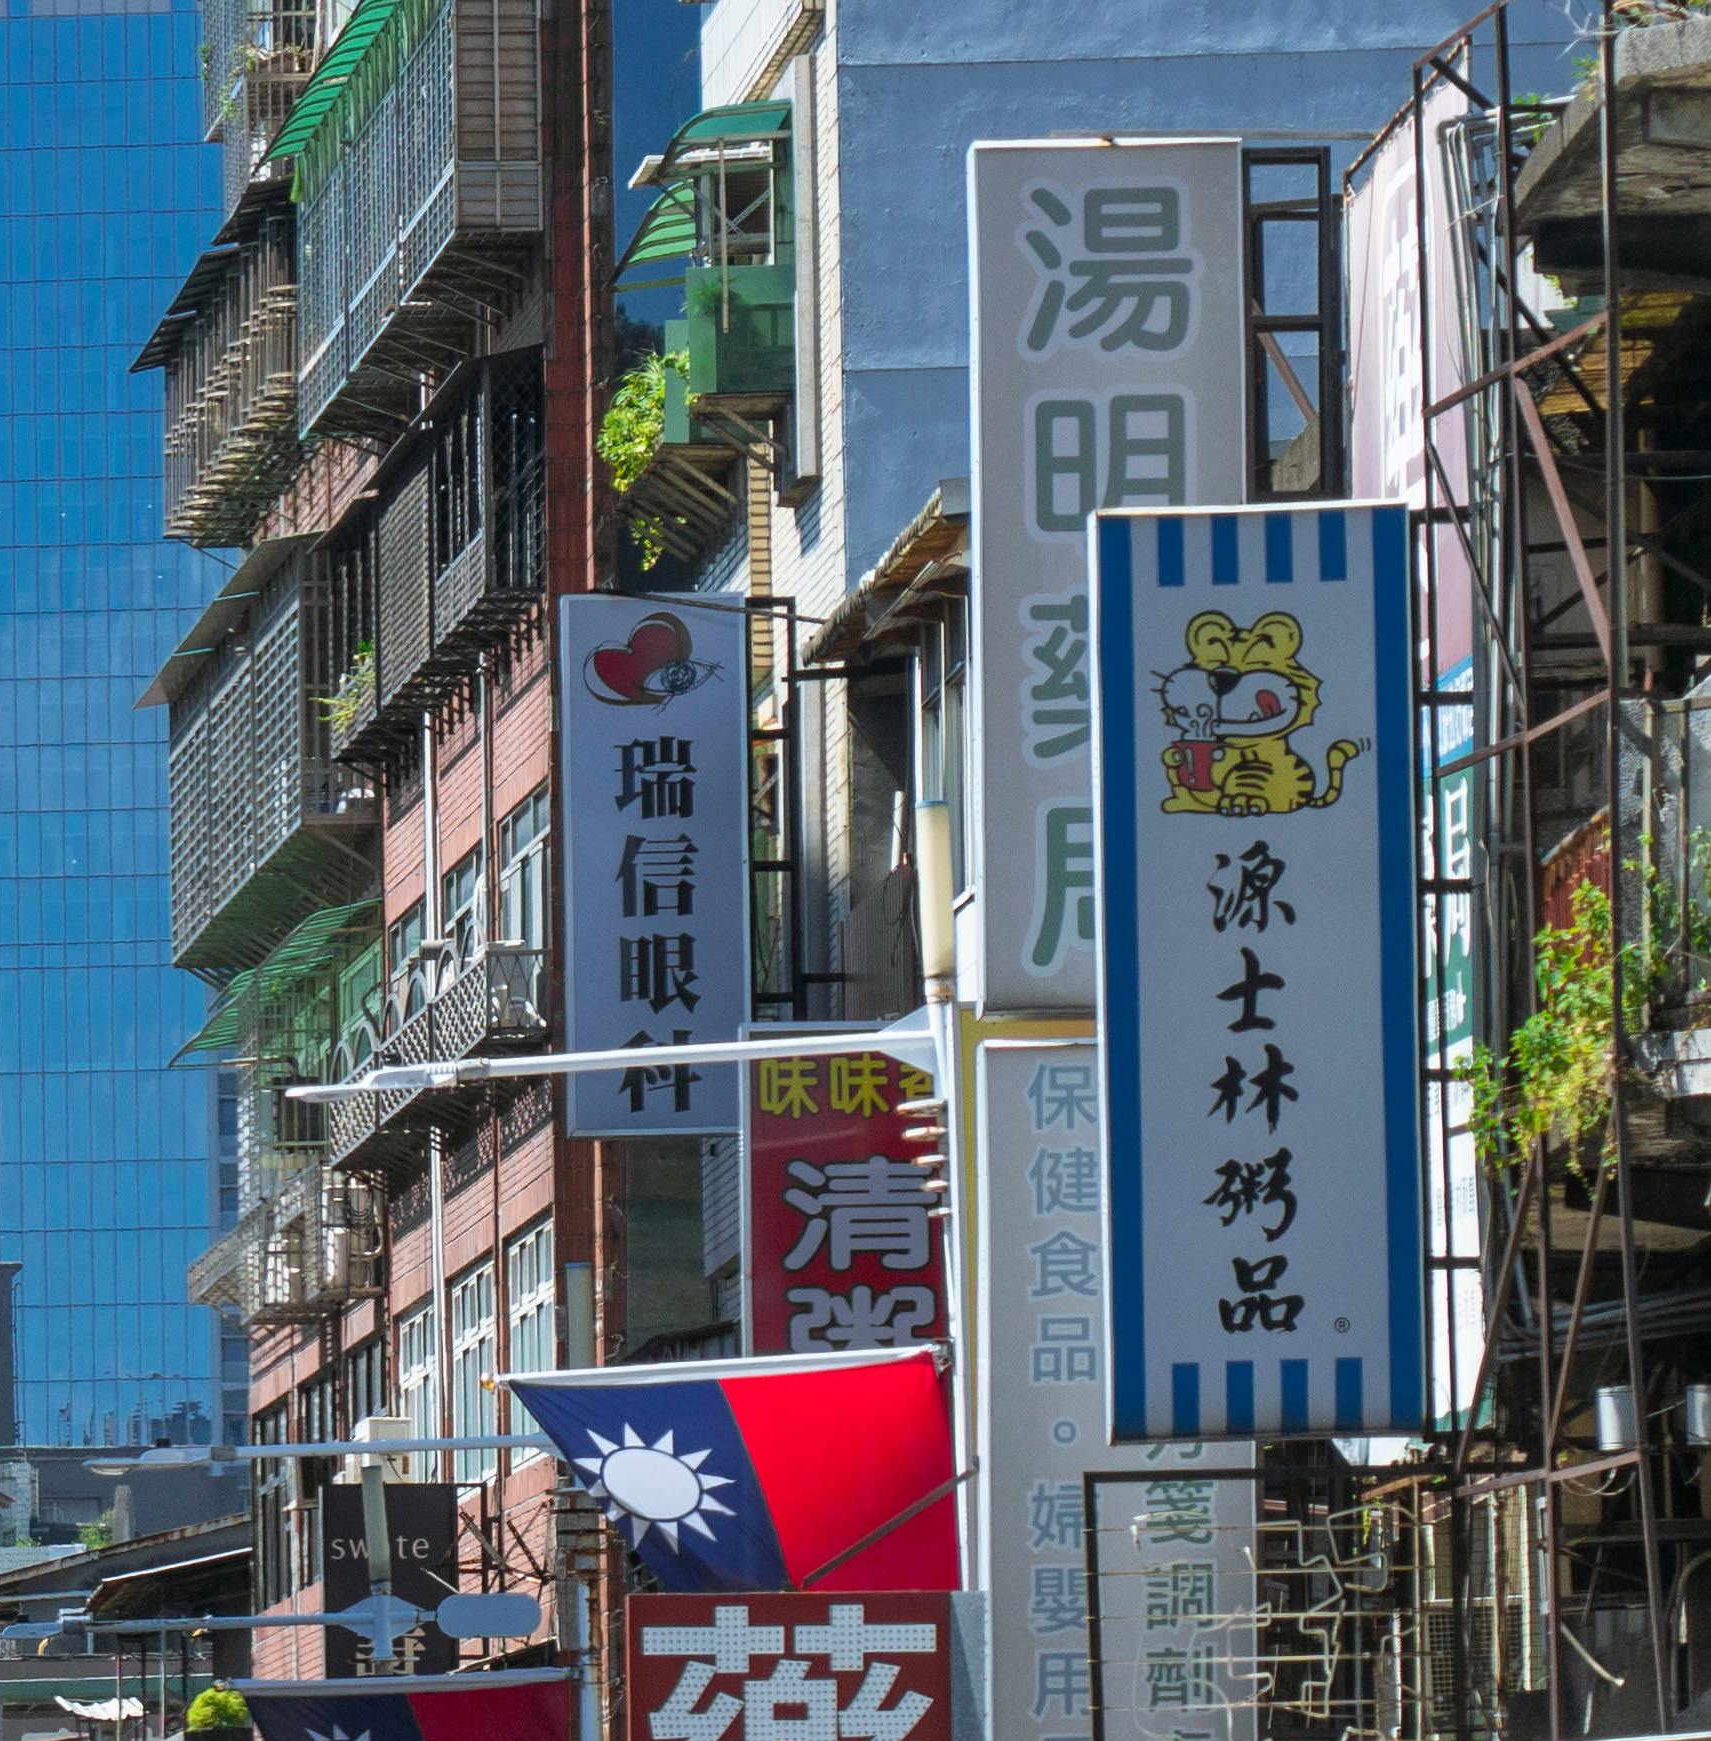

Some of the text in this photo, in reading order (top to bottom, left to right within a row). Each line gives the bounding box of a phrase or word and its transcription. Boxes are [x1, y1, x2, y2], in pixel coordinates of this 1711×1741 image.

[614, 736, 702, 1111] 瑞信眼科
[1204, 840, 1305, 1335] 源士林粥品
